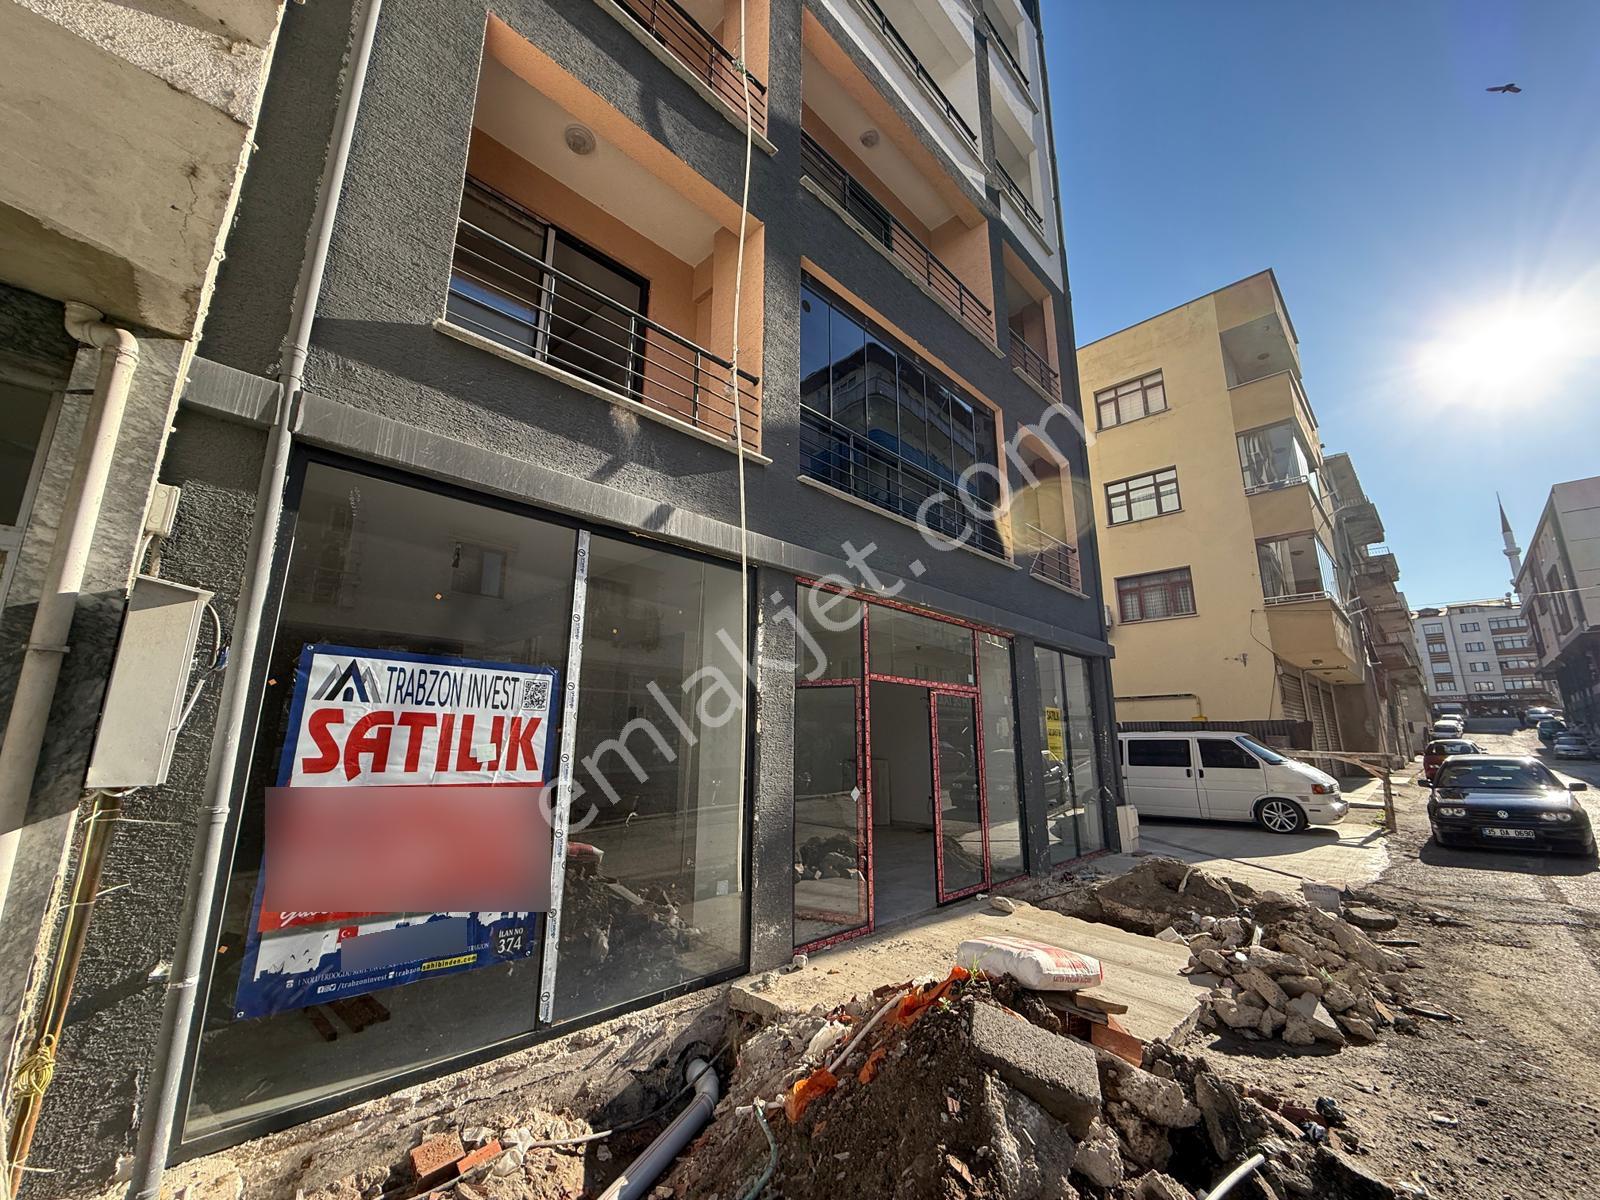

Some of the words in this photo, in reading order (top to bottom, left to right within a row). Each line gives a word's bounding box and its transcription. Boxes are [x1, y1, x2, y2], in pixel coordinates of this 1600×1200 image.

[386, 666, 464, 707] TRABZON
[466, 673, 520, 710] INVEST
[302, 708, 542, 781] SATILIK
[497, 936, 522, 954] 374
[513, 927, 524, 936] NO
